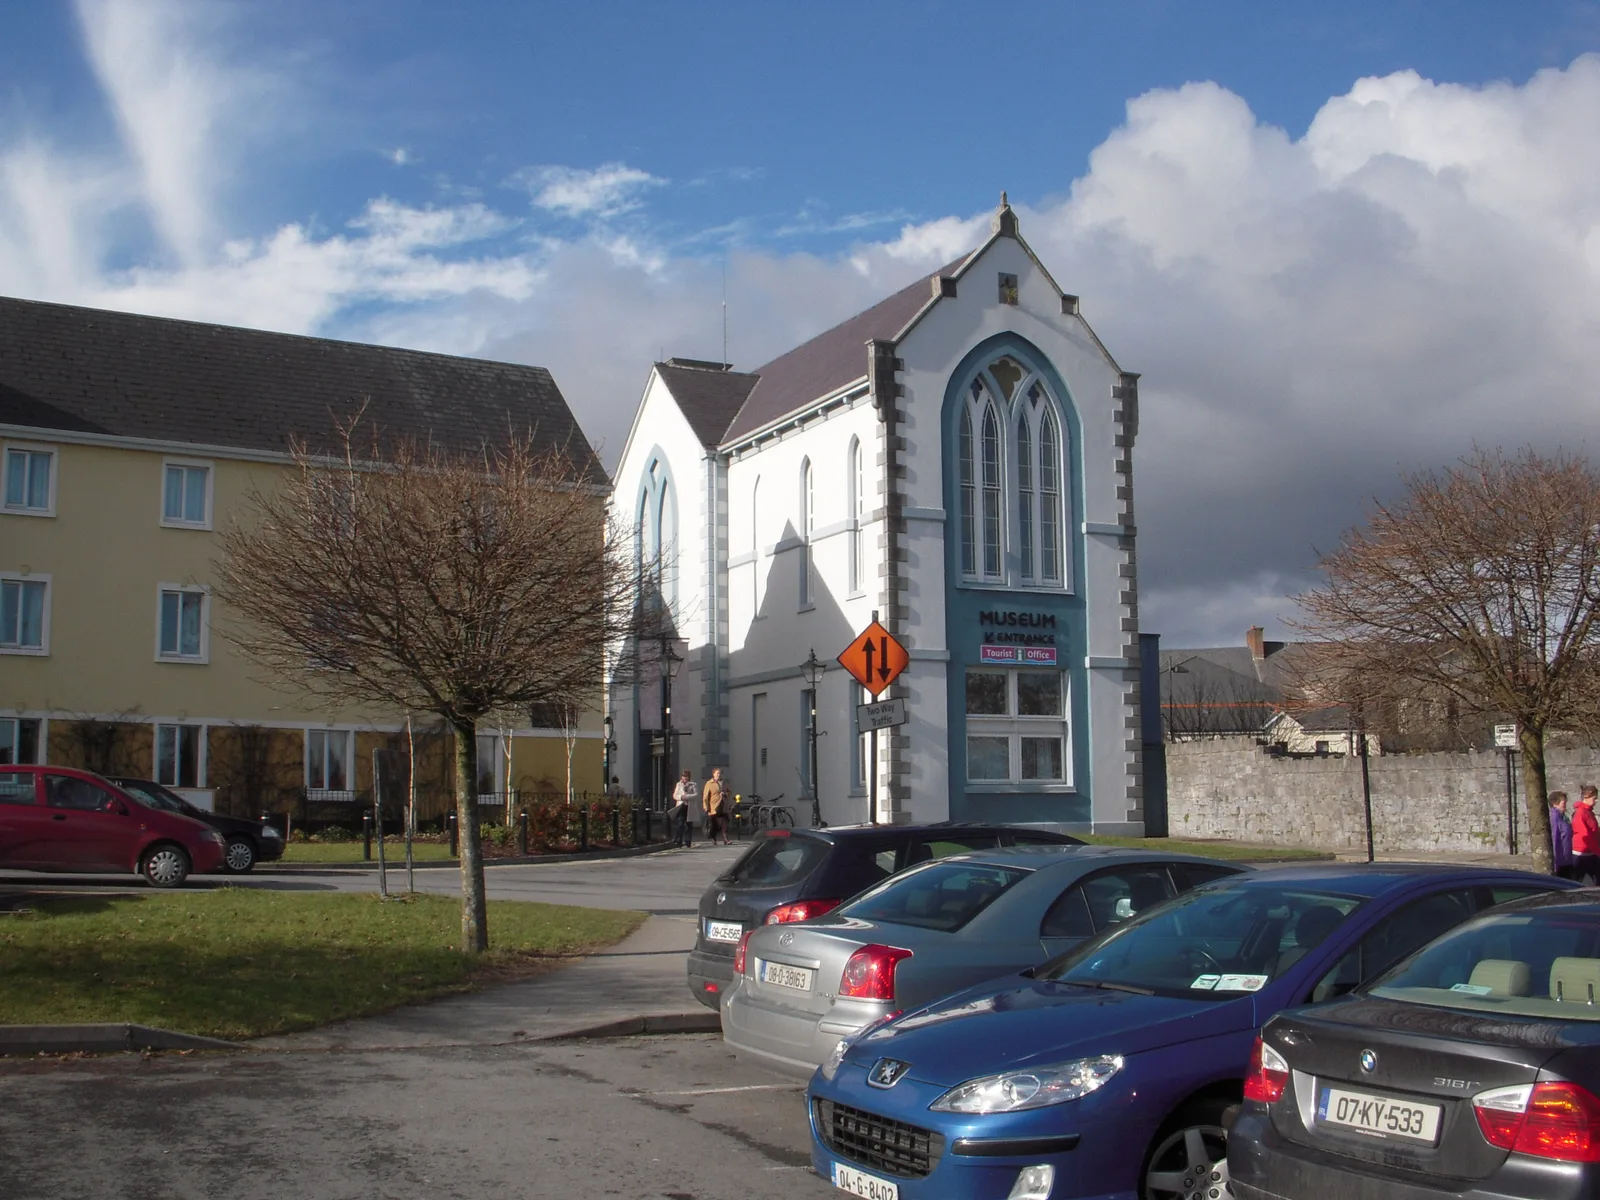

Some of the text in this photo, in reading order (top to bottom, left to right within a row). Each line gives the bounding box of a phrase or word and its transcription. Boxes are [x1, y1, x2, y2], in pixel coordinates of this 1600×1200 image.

[979, 610, 1056, 628] MUSEUM
[997, 632, 1055, 644] ENTRANCE
[987, 649, 1013, 658] Tourist
[1027, 650, 1050, 659] Office
[866, 703, 895, 715] Two Way
[871, 716, 893, 726] Traffic
